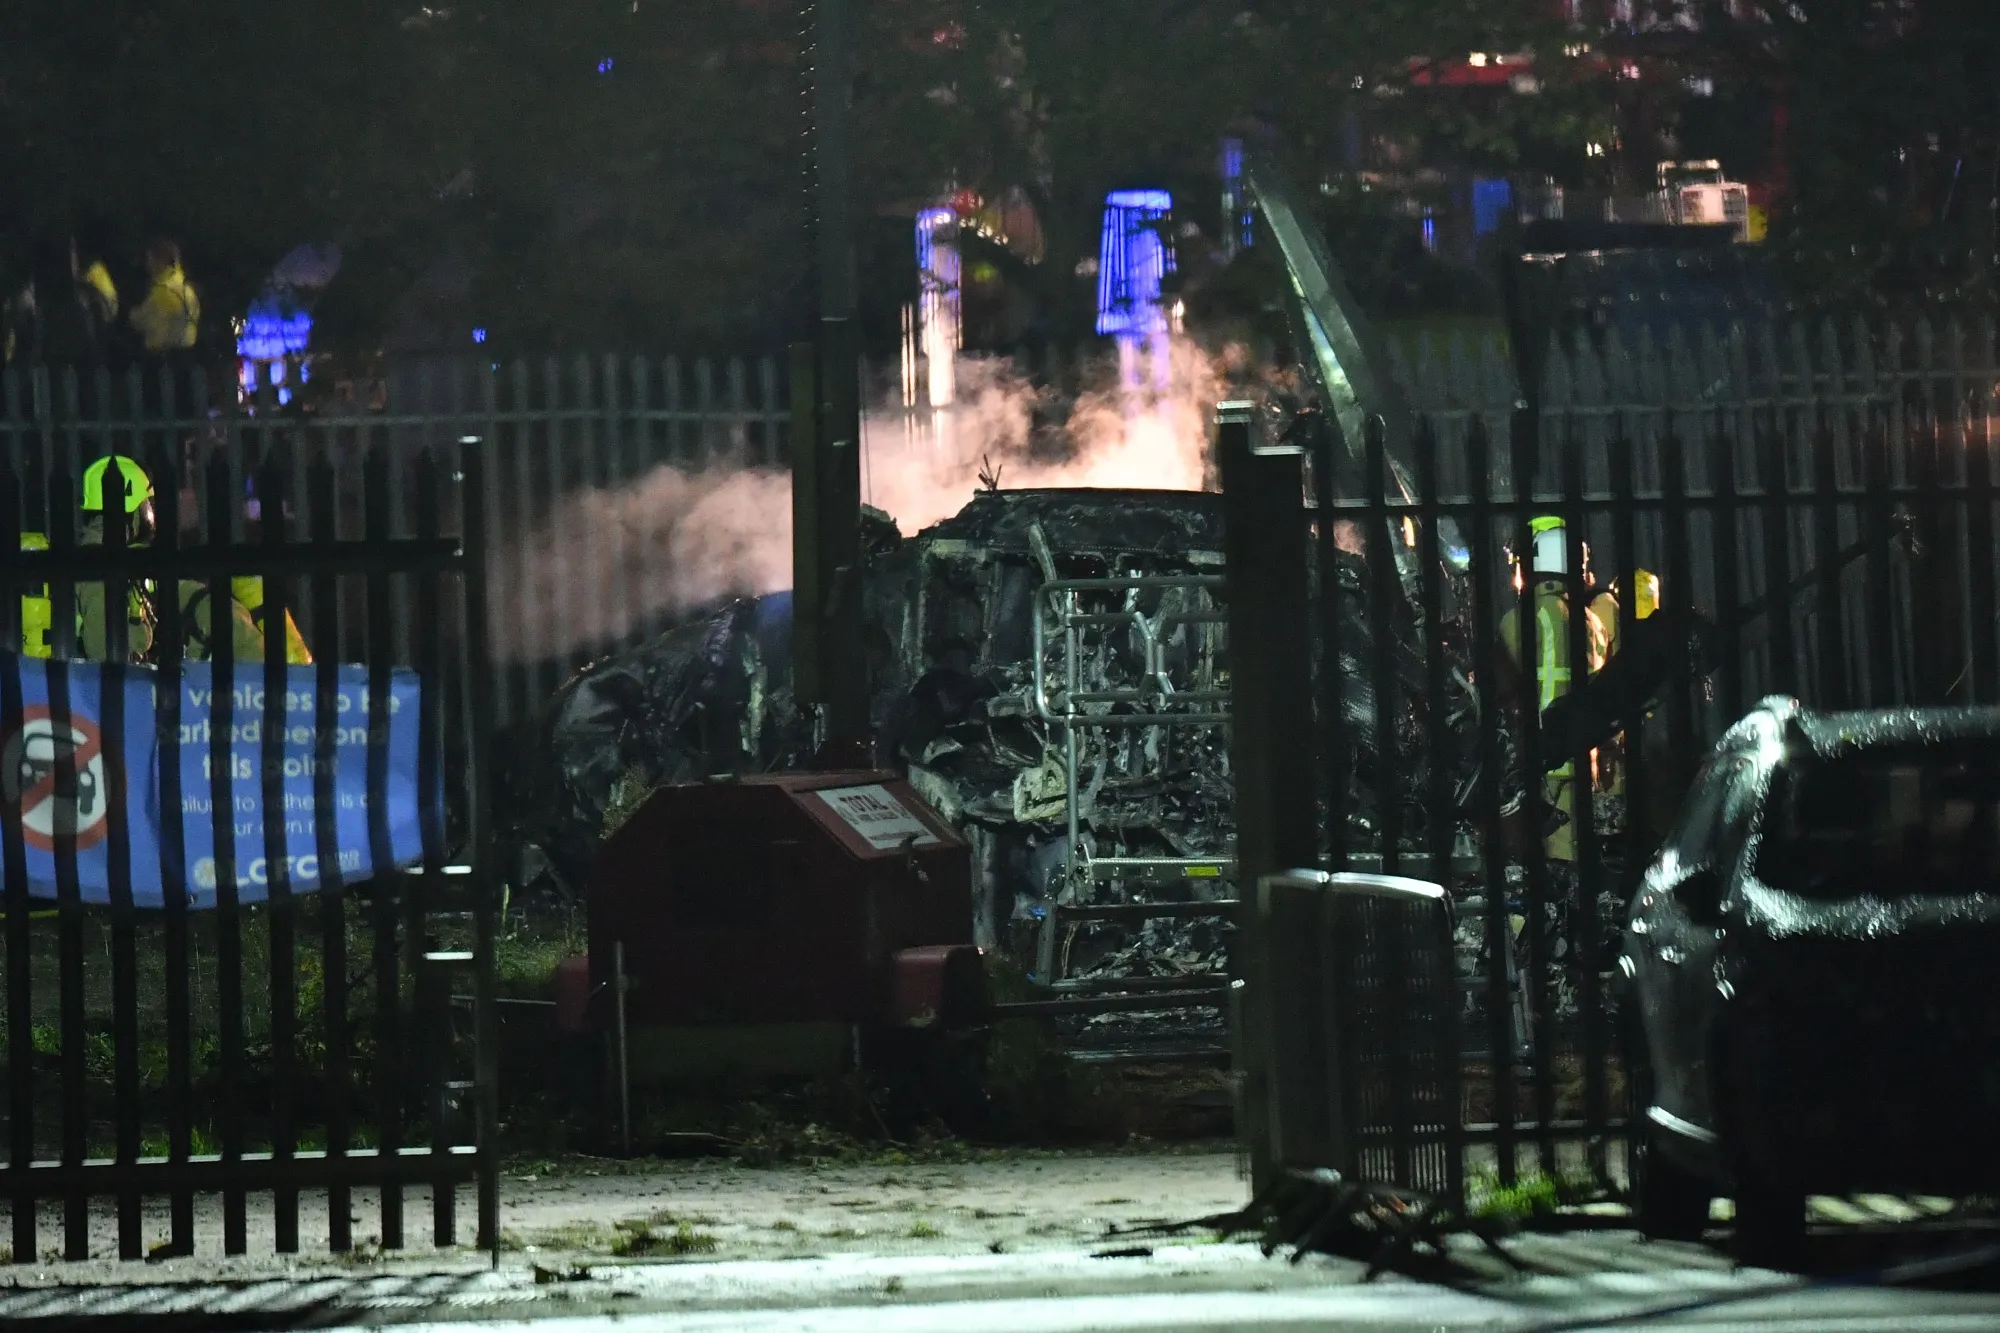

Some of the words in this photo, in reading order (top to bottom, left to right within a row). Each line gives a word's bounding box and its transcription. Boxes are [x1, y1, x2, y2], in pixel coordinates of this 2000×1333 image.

[188, 683, 314, 713] vhices
[323, 689, 352, 714] o
[157, 718, 261, 747] arkd
[272, 720, 388, 750] eon
[202, 753, 253, 781] tis
[267, 753, 339, 784] oin
